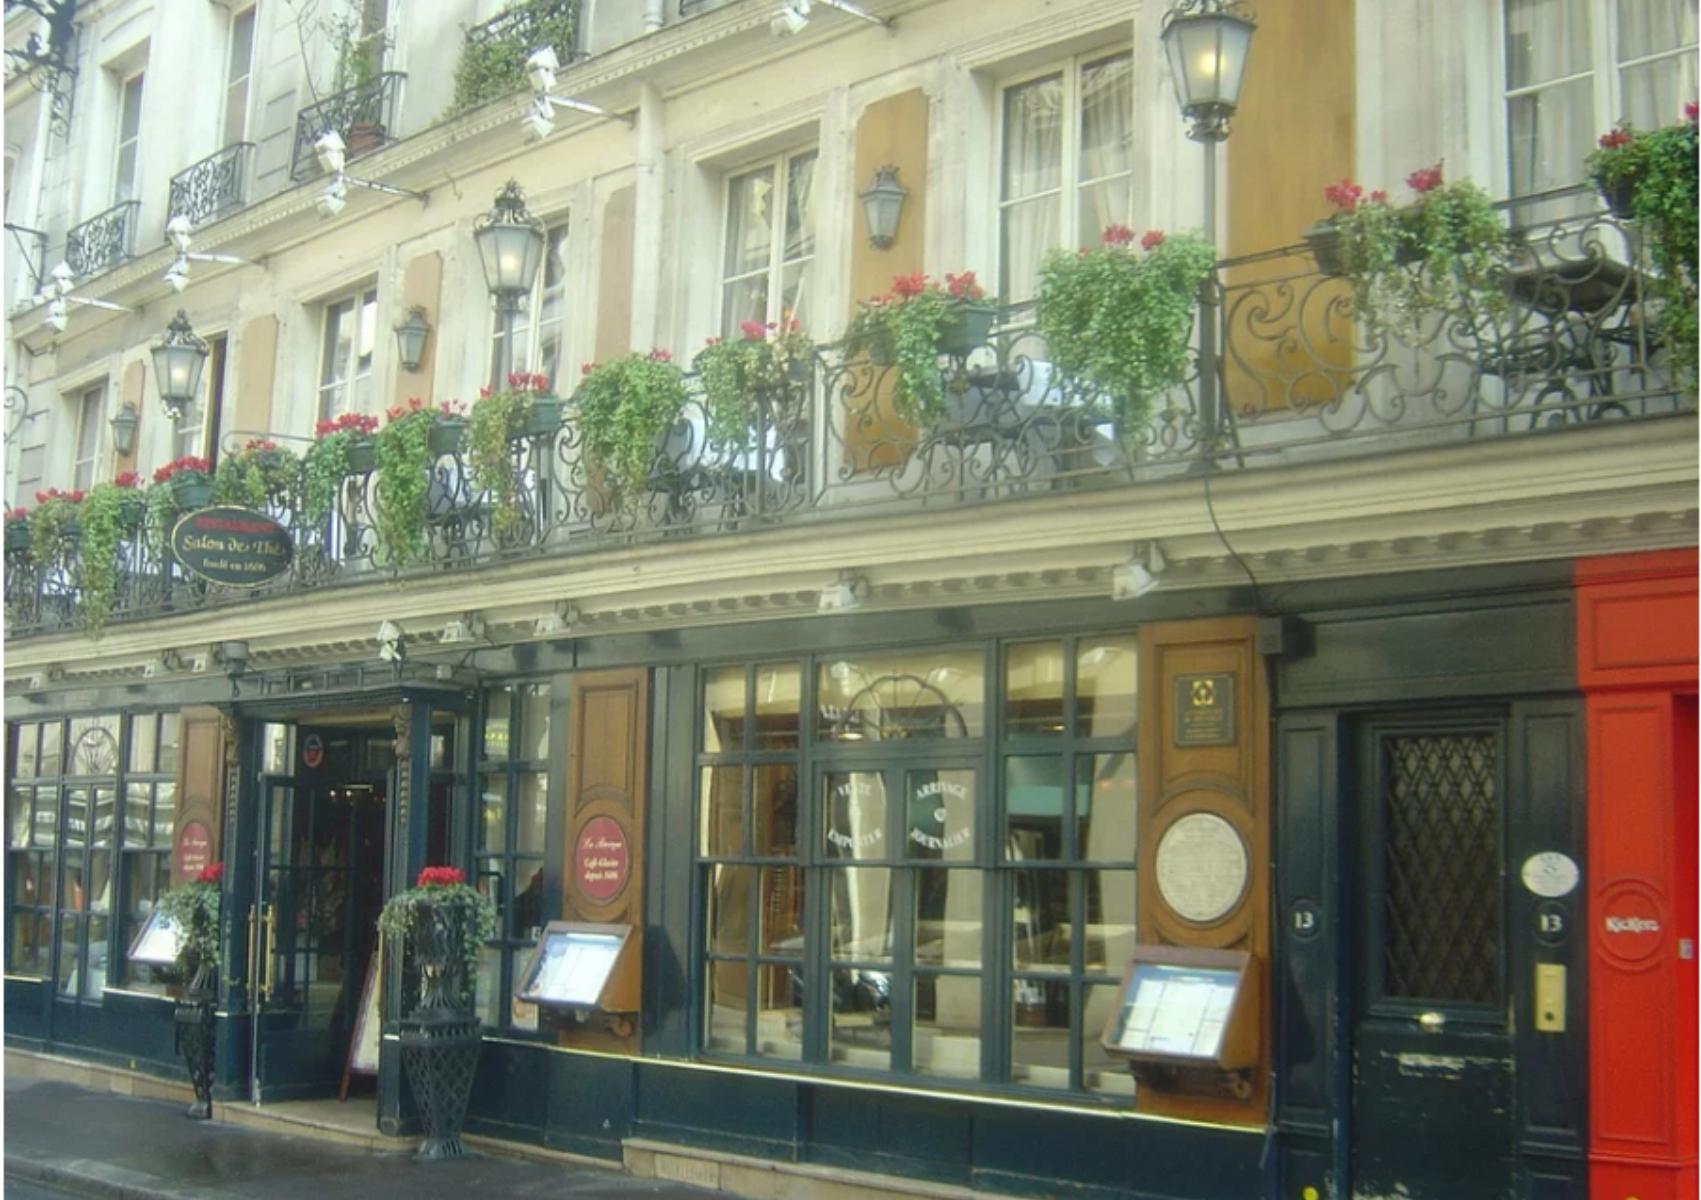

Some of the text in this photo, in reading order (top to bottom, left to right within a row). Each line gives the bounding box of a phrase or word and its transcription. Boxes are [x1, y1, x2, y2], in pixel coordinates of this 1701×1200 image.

[182, 534, 224, 551] Salon
[227, 537, 250, 553] de
[916, 781, 968, 800] ARRIVAGE
[1295, 911, 1313, 929] 13
[1540, 914, 1562, 932] 13
